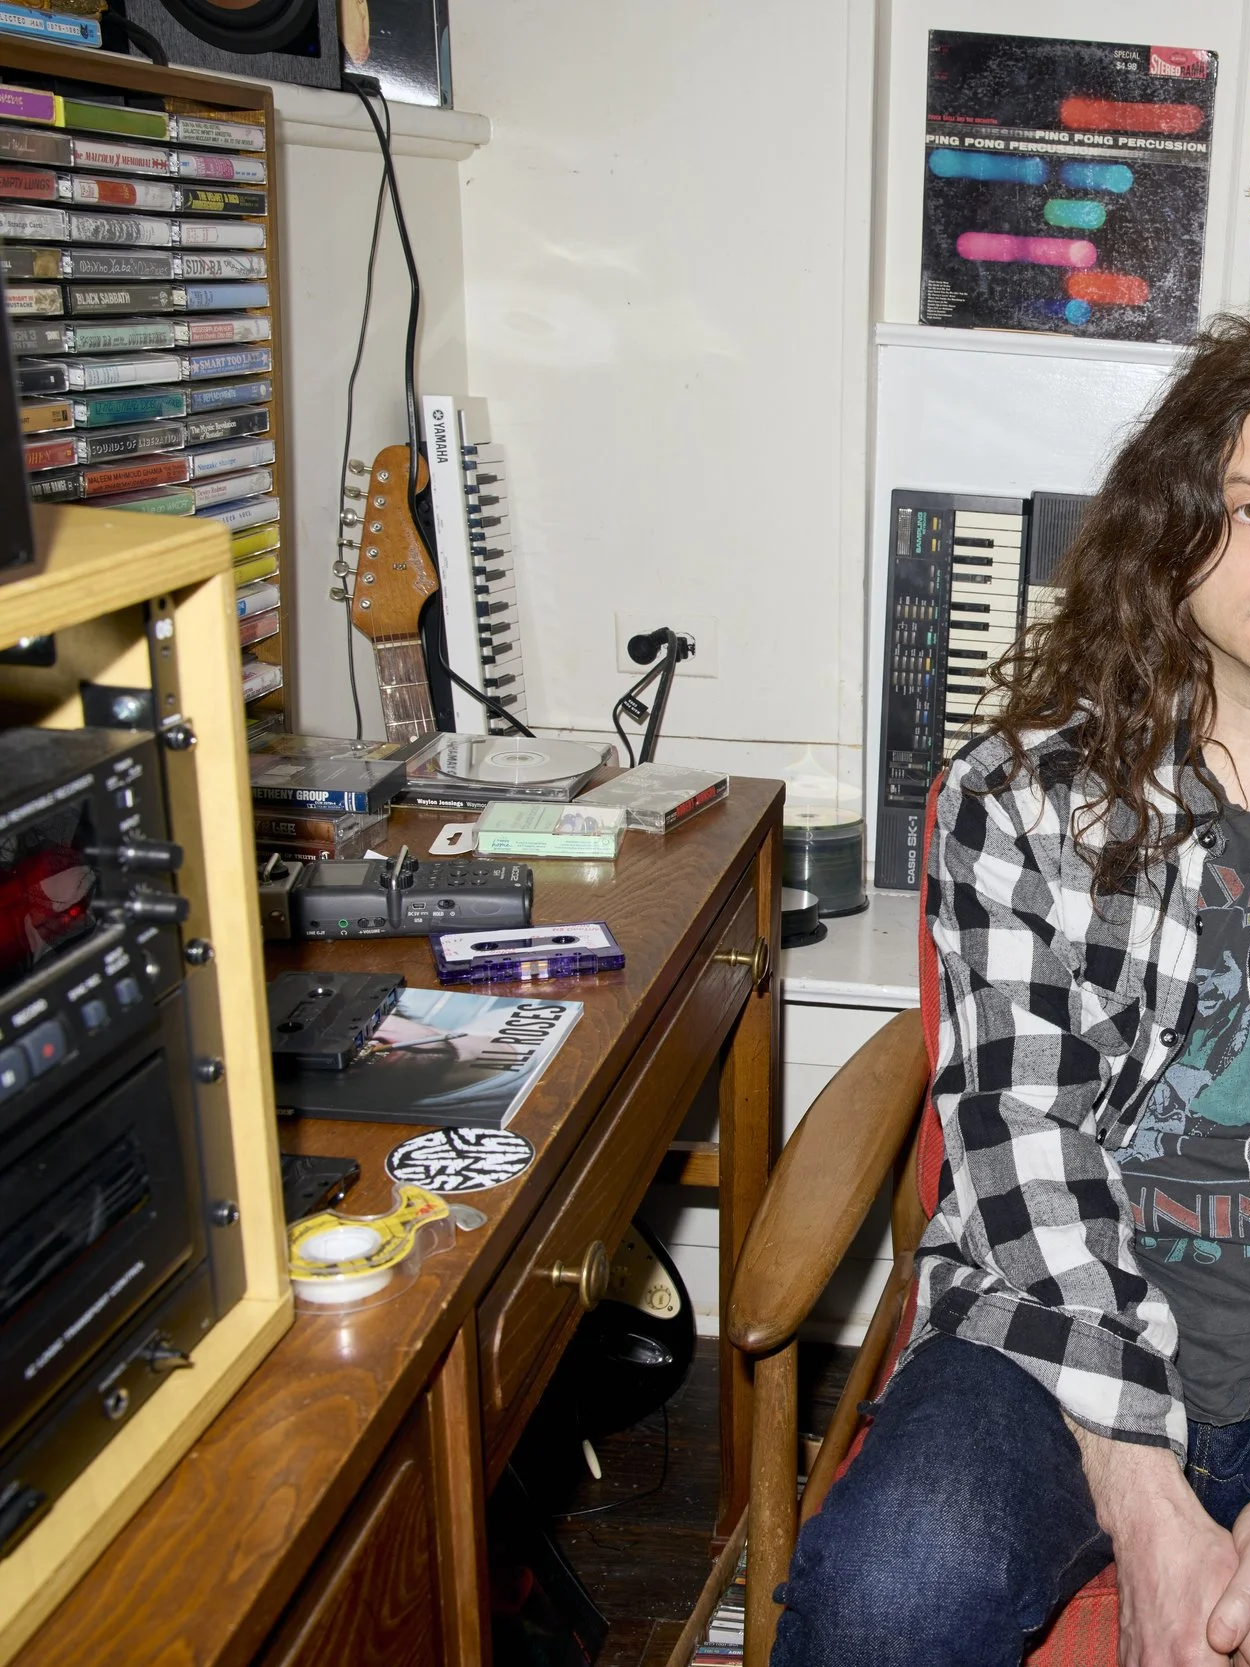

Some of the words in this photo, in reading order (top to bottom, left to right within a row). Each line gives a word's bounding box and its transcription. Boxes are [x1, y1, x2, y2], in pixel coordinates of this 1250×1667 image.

[1114, 50, 1140, 59] SPECIAL
[1116, 62, 1137, 70] $4.98
[926, 135, 959, 145] PING
[965, 138, 1005, 149] PONG
[1035, 131, 1069, 141] PING
[1074, 134, 1113, 145] PONG
[1119, 138, 1207, 152] PERCUSSION
[24, 178, 50, 191] LUNGS
[75, 293, 100, 305] BLACK
[101, 292, 131, 304] SABBATH
[200, 359, 226, 370] SMART
[91, 443, 124, 455] SOUNDS
[433, 422, 448, 464] YAMAHA
[296, 790, 329, 802] GROUP
[439, 800, 464, 808] Jennings
[272, 822, 296, 835] LEE
[906, 815, 919, 847] SK-1
[906, 849, 917, 884] CASIO
[490, 1002, 568, 1056] ROSES
[470, 1047, 535, 1073] ALL
